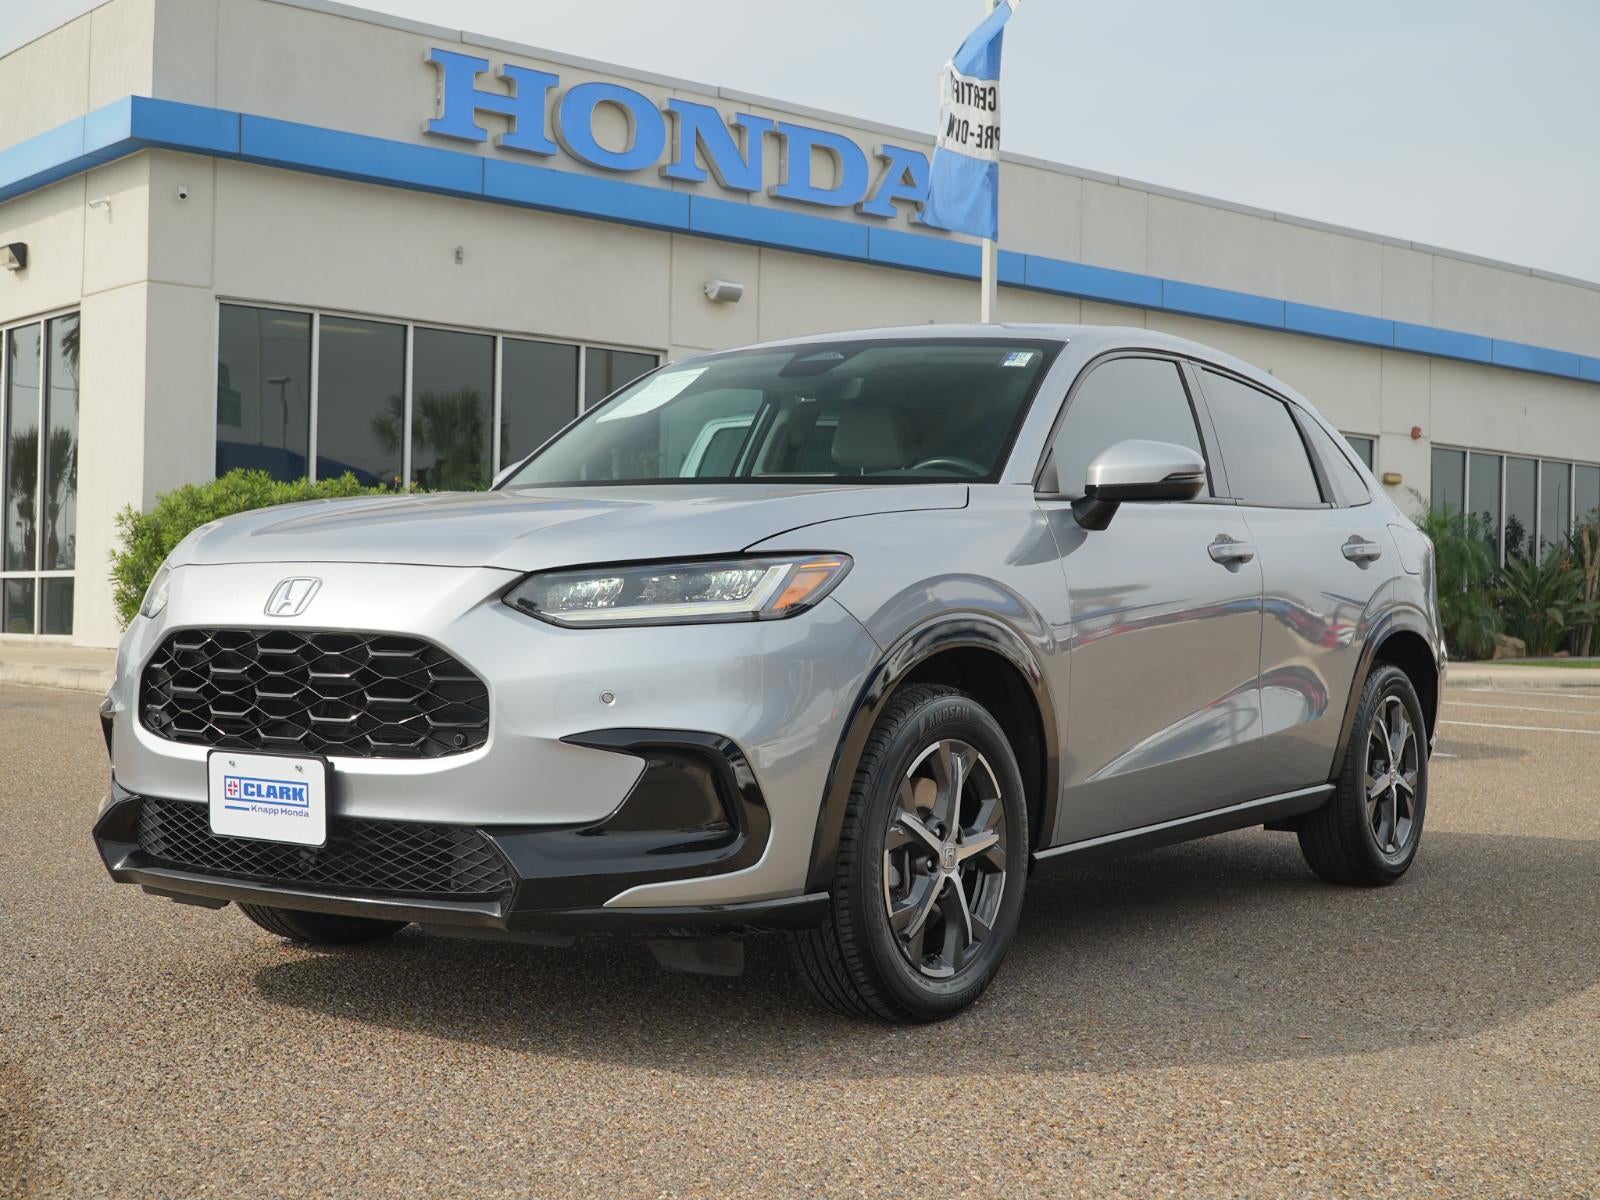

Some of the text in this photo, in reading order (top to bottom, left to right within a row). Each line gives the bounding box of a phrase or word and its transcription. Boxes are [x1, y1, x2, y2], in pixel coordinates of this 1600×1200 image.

[423, 47, 933, 228] HONDA
[243, 782, 305, 802] CLARK
[251, 805, 309, 817] Knapp Honda
